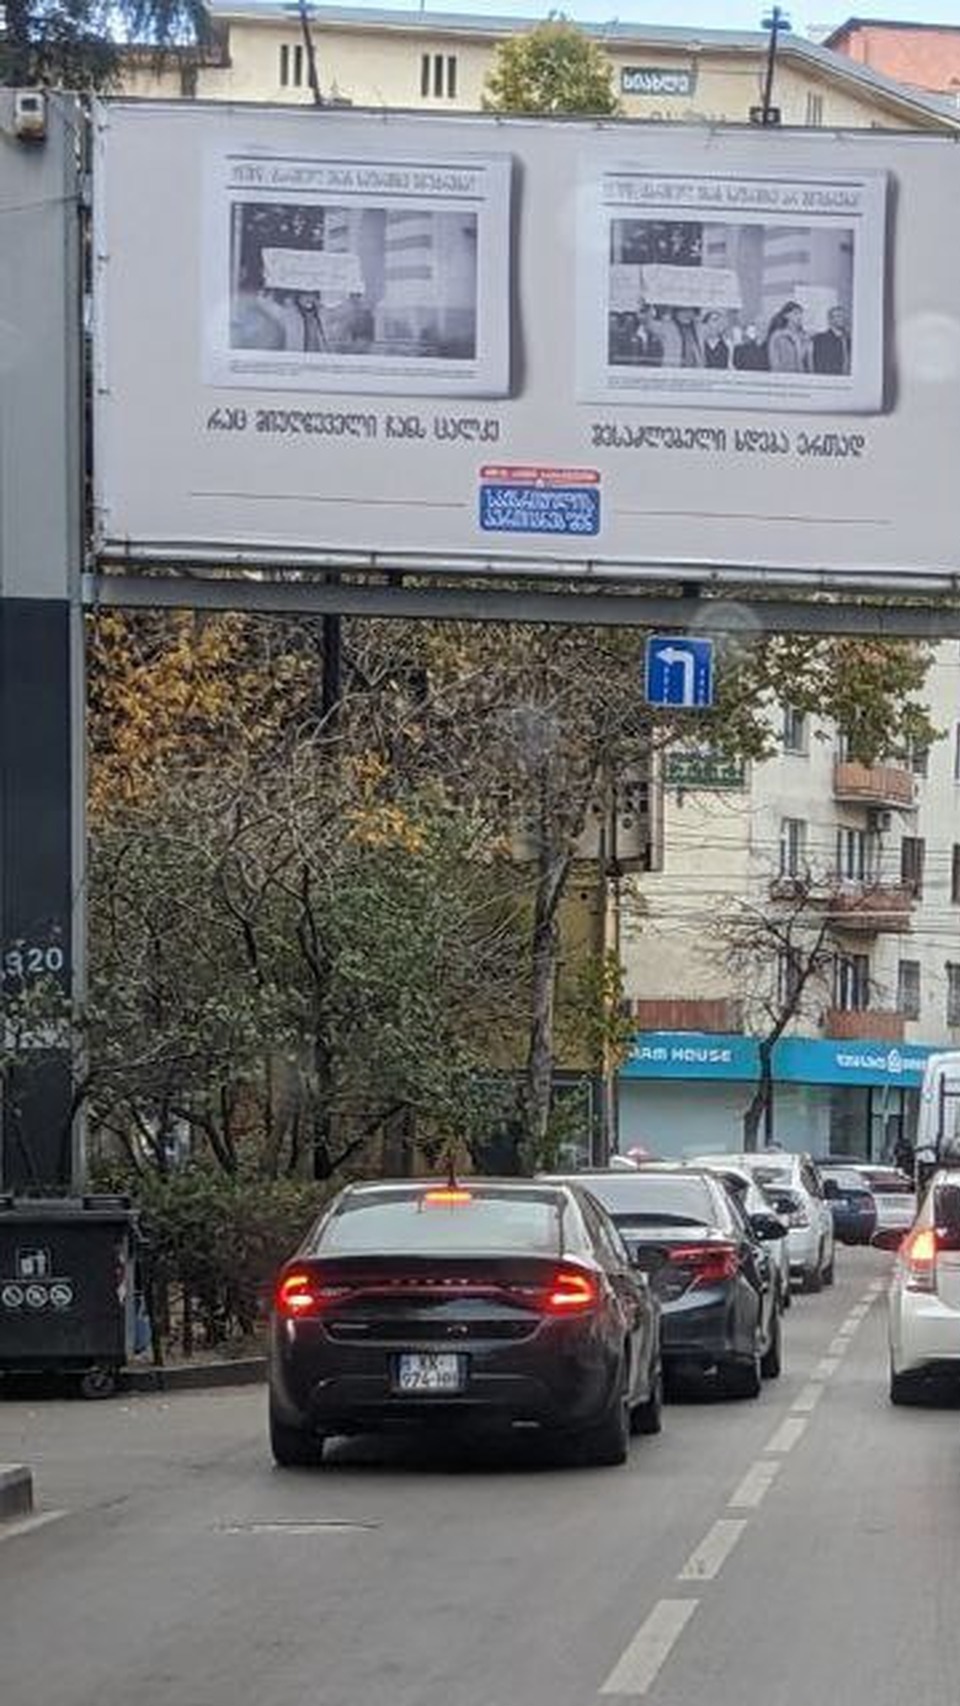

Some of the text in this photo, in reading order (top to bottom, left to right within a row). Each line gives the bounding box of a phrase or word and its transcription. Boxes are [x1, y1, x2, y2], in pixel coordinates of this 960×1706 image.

[207, 408, 247, 431] რაც
[385, 415, 427, 439] ჩანს
[433, 416, 500, 441] ცალკე
[591, 424, 866, 457] შესაძლებელი ხდება ერთად
[671, 1048, 732, 1062] HOUSE
